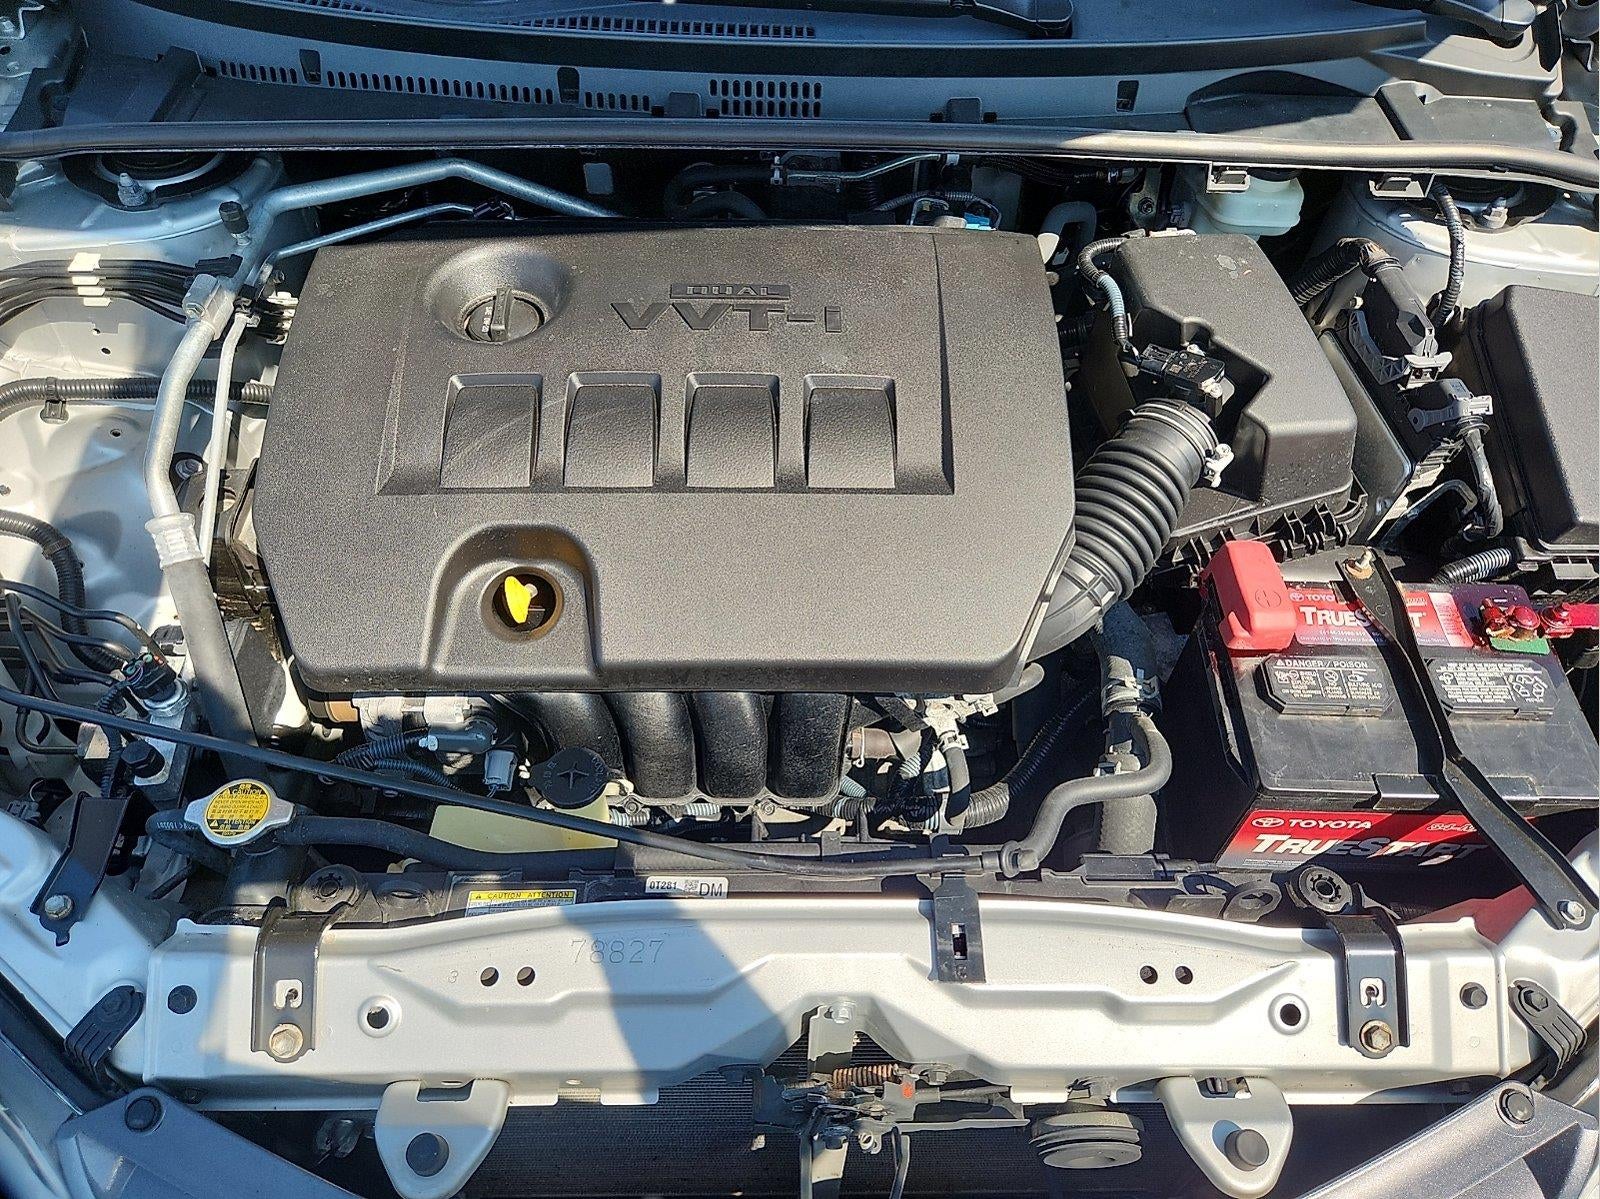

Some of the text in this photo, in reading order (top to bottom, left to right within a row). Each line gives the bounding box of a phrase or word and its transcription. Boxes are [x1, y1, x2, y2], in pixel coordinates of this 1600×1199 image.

[686, 285, 782, 297] DUAL
[1306, 593, 1336, 602] TOYO
[1285, 659, 1324, 668] DANGER
[1333, 660, 1369, 669] POISON
[232, 788, 263, 796] CAUTION
[1288, 818, 1372, 830] TOYOTA
[487, 890, 570, 900] CAUTION ATTENTION
[699, 882, 723, 897] DM
[571, 938, 666, 965] 78827
